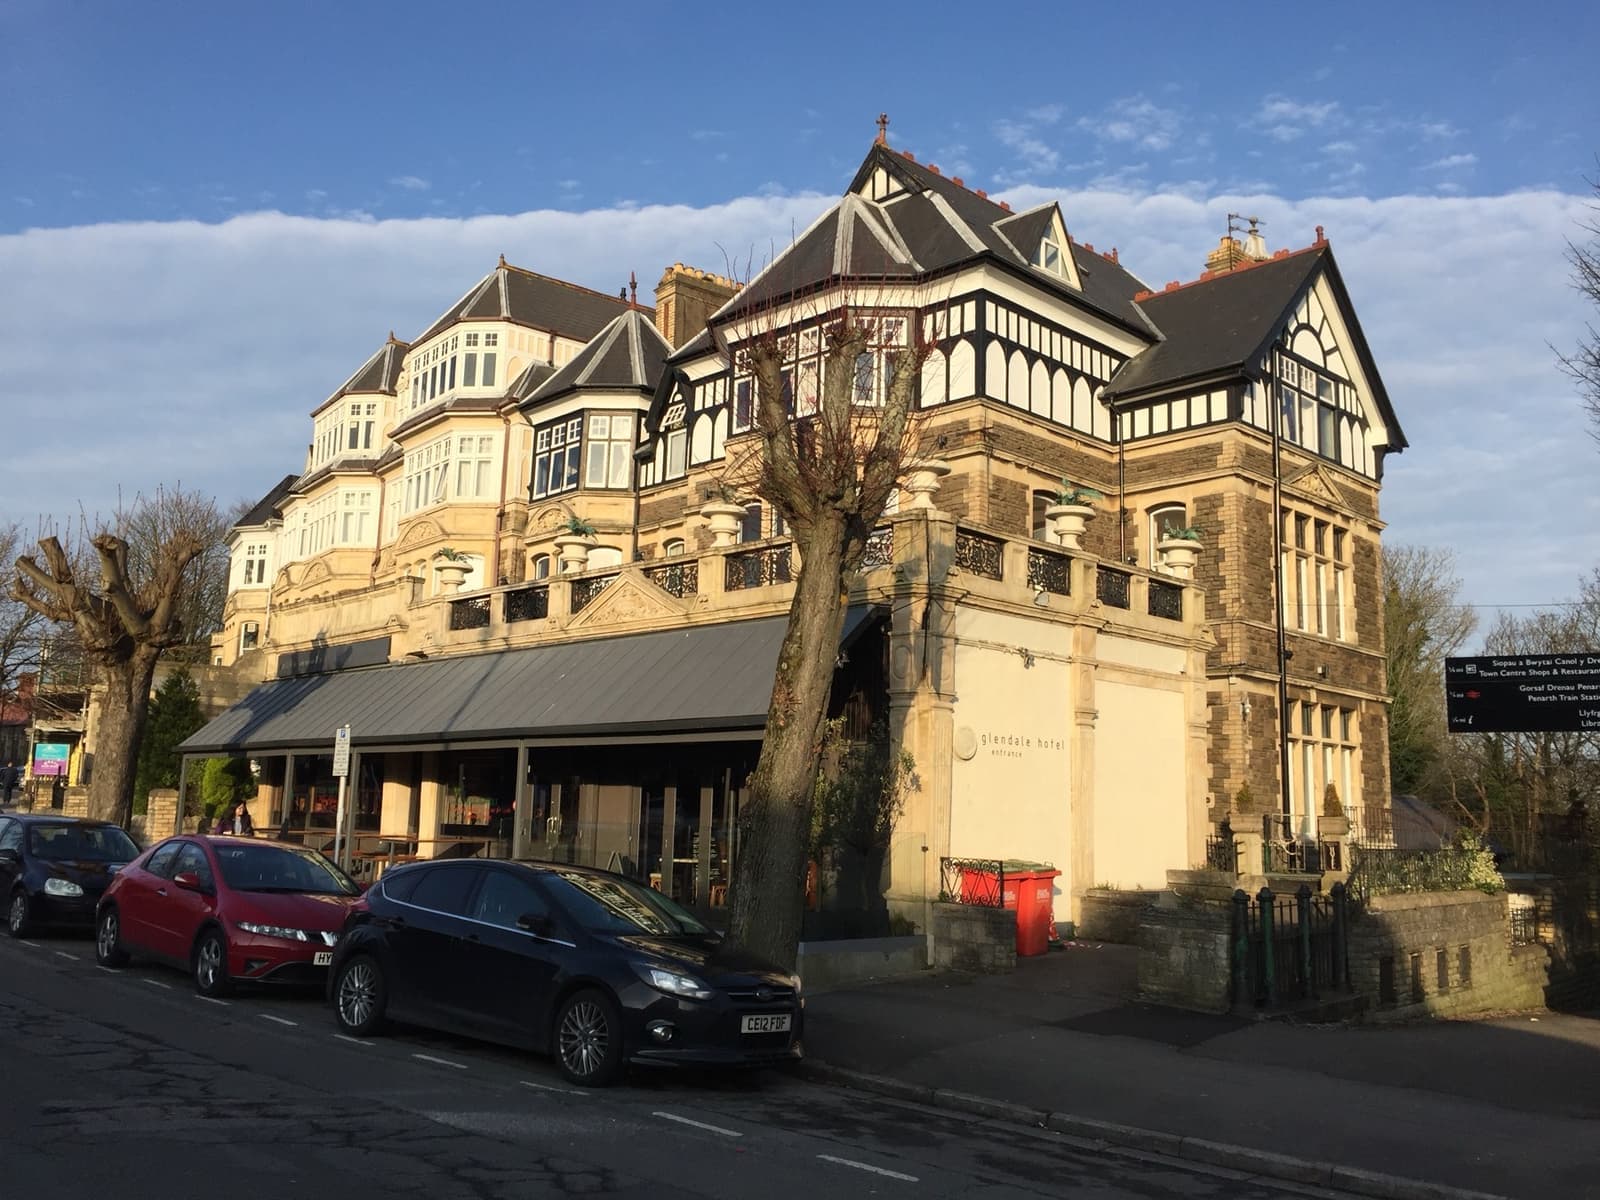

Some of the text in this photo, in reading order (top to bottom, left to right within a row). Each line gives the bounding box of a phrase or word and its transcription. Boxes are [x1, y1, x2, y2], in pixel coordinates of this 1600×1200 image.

[1500, 669, 1526, 677] Centre
[1528, 668, 1550, 677] Shops
[1519, 684, 1545, 692] Gorsaf
[1528, 694, 1558, 702] Penarth
[981, 732, 1065, 750] glendale hotel
[991, 749, 1022, 758] entrance
[747, 1017, 769, 1031] CE12
